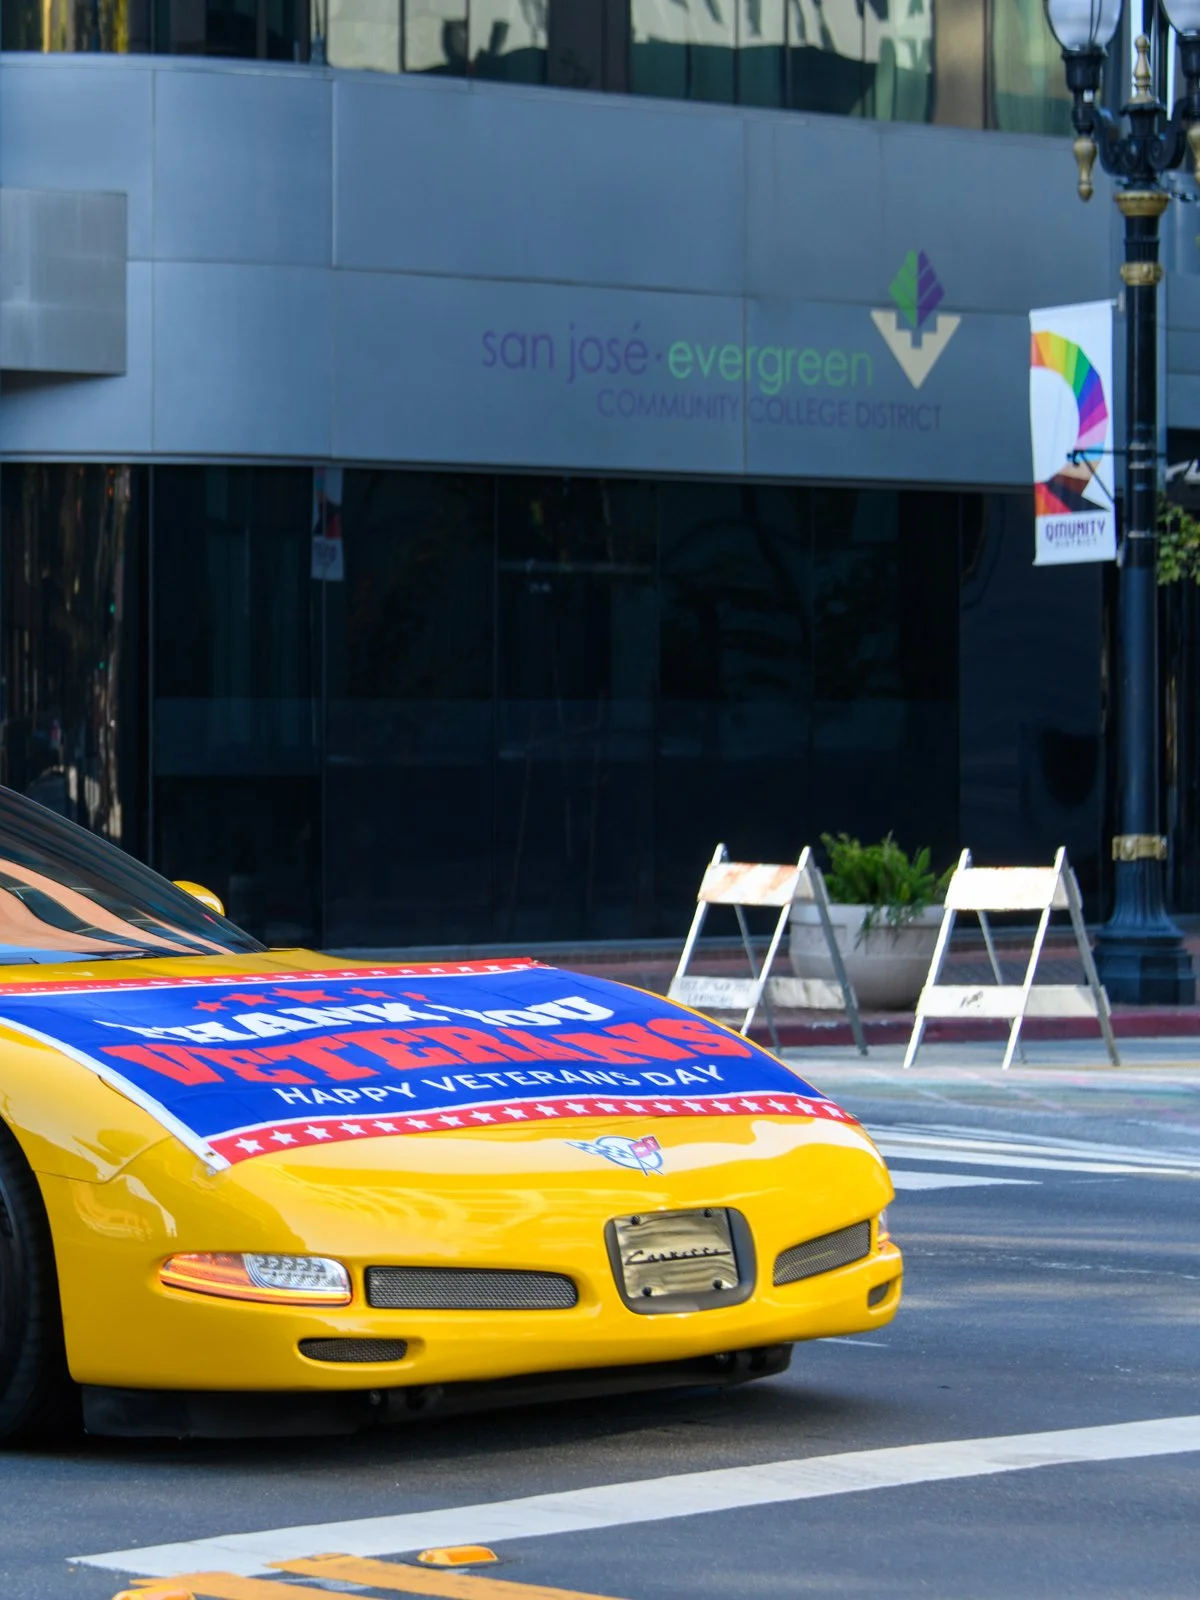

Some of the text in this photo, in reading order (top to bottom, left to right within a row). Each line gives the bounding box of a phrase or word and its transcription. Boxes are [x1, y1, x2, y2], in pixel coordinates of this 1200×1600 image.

[481, 321, 874, 395] san josé evergreen
[597, 389, 942, 432] COMMUNITY COLLEGE DISTRICT
[92, 996, 615, 1043] THANK YOU
[99, 1018, 753, 1086] VETERANS
[272, 1064, 728, 1105] HAPPY VETERANS DAY
